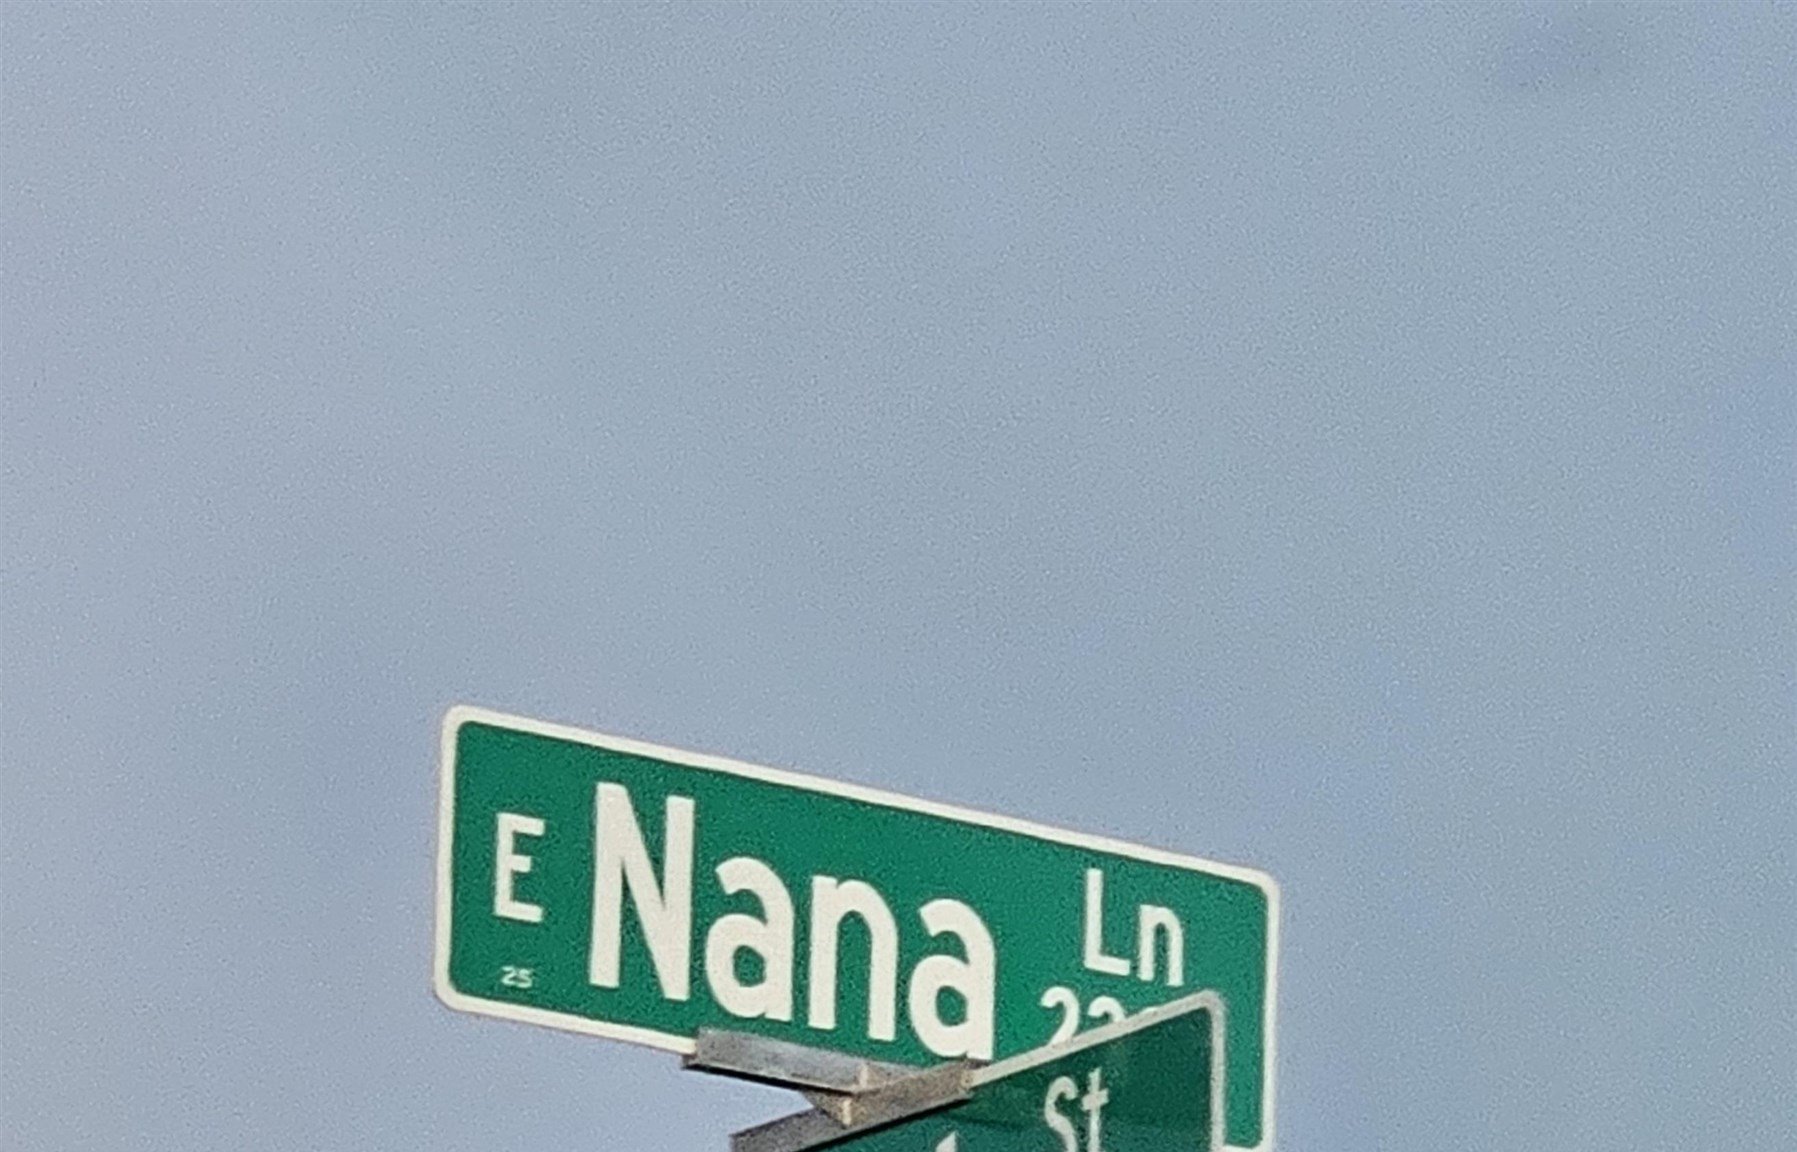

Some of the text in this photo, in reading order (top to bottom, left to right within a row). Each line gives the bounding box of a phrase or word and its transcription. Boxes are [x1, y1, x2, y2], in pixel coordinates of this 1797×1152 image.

[494, 812, 545, 923] E
[590, 781, 996, 1061] Nana
[1084, 868, 1184, 986] Ln
[501, 966, 533, 989] 25
